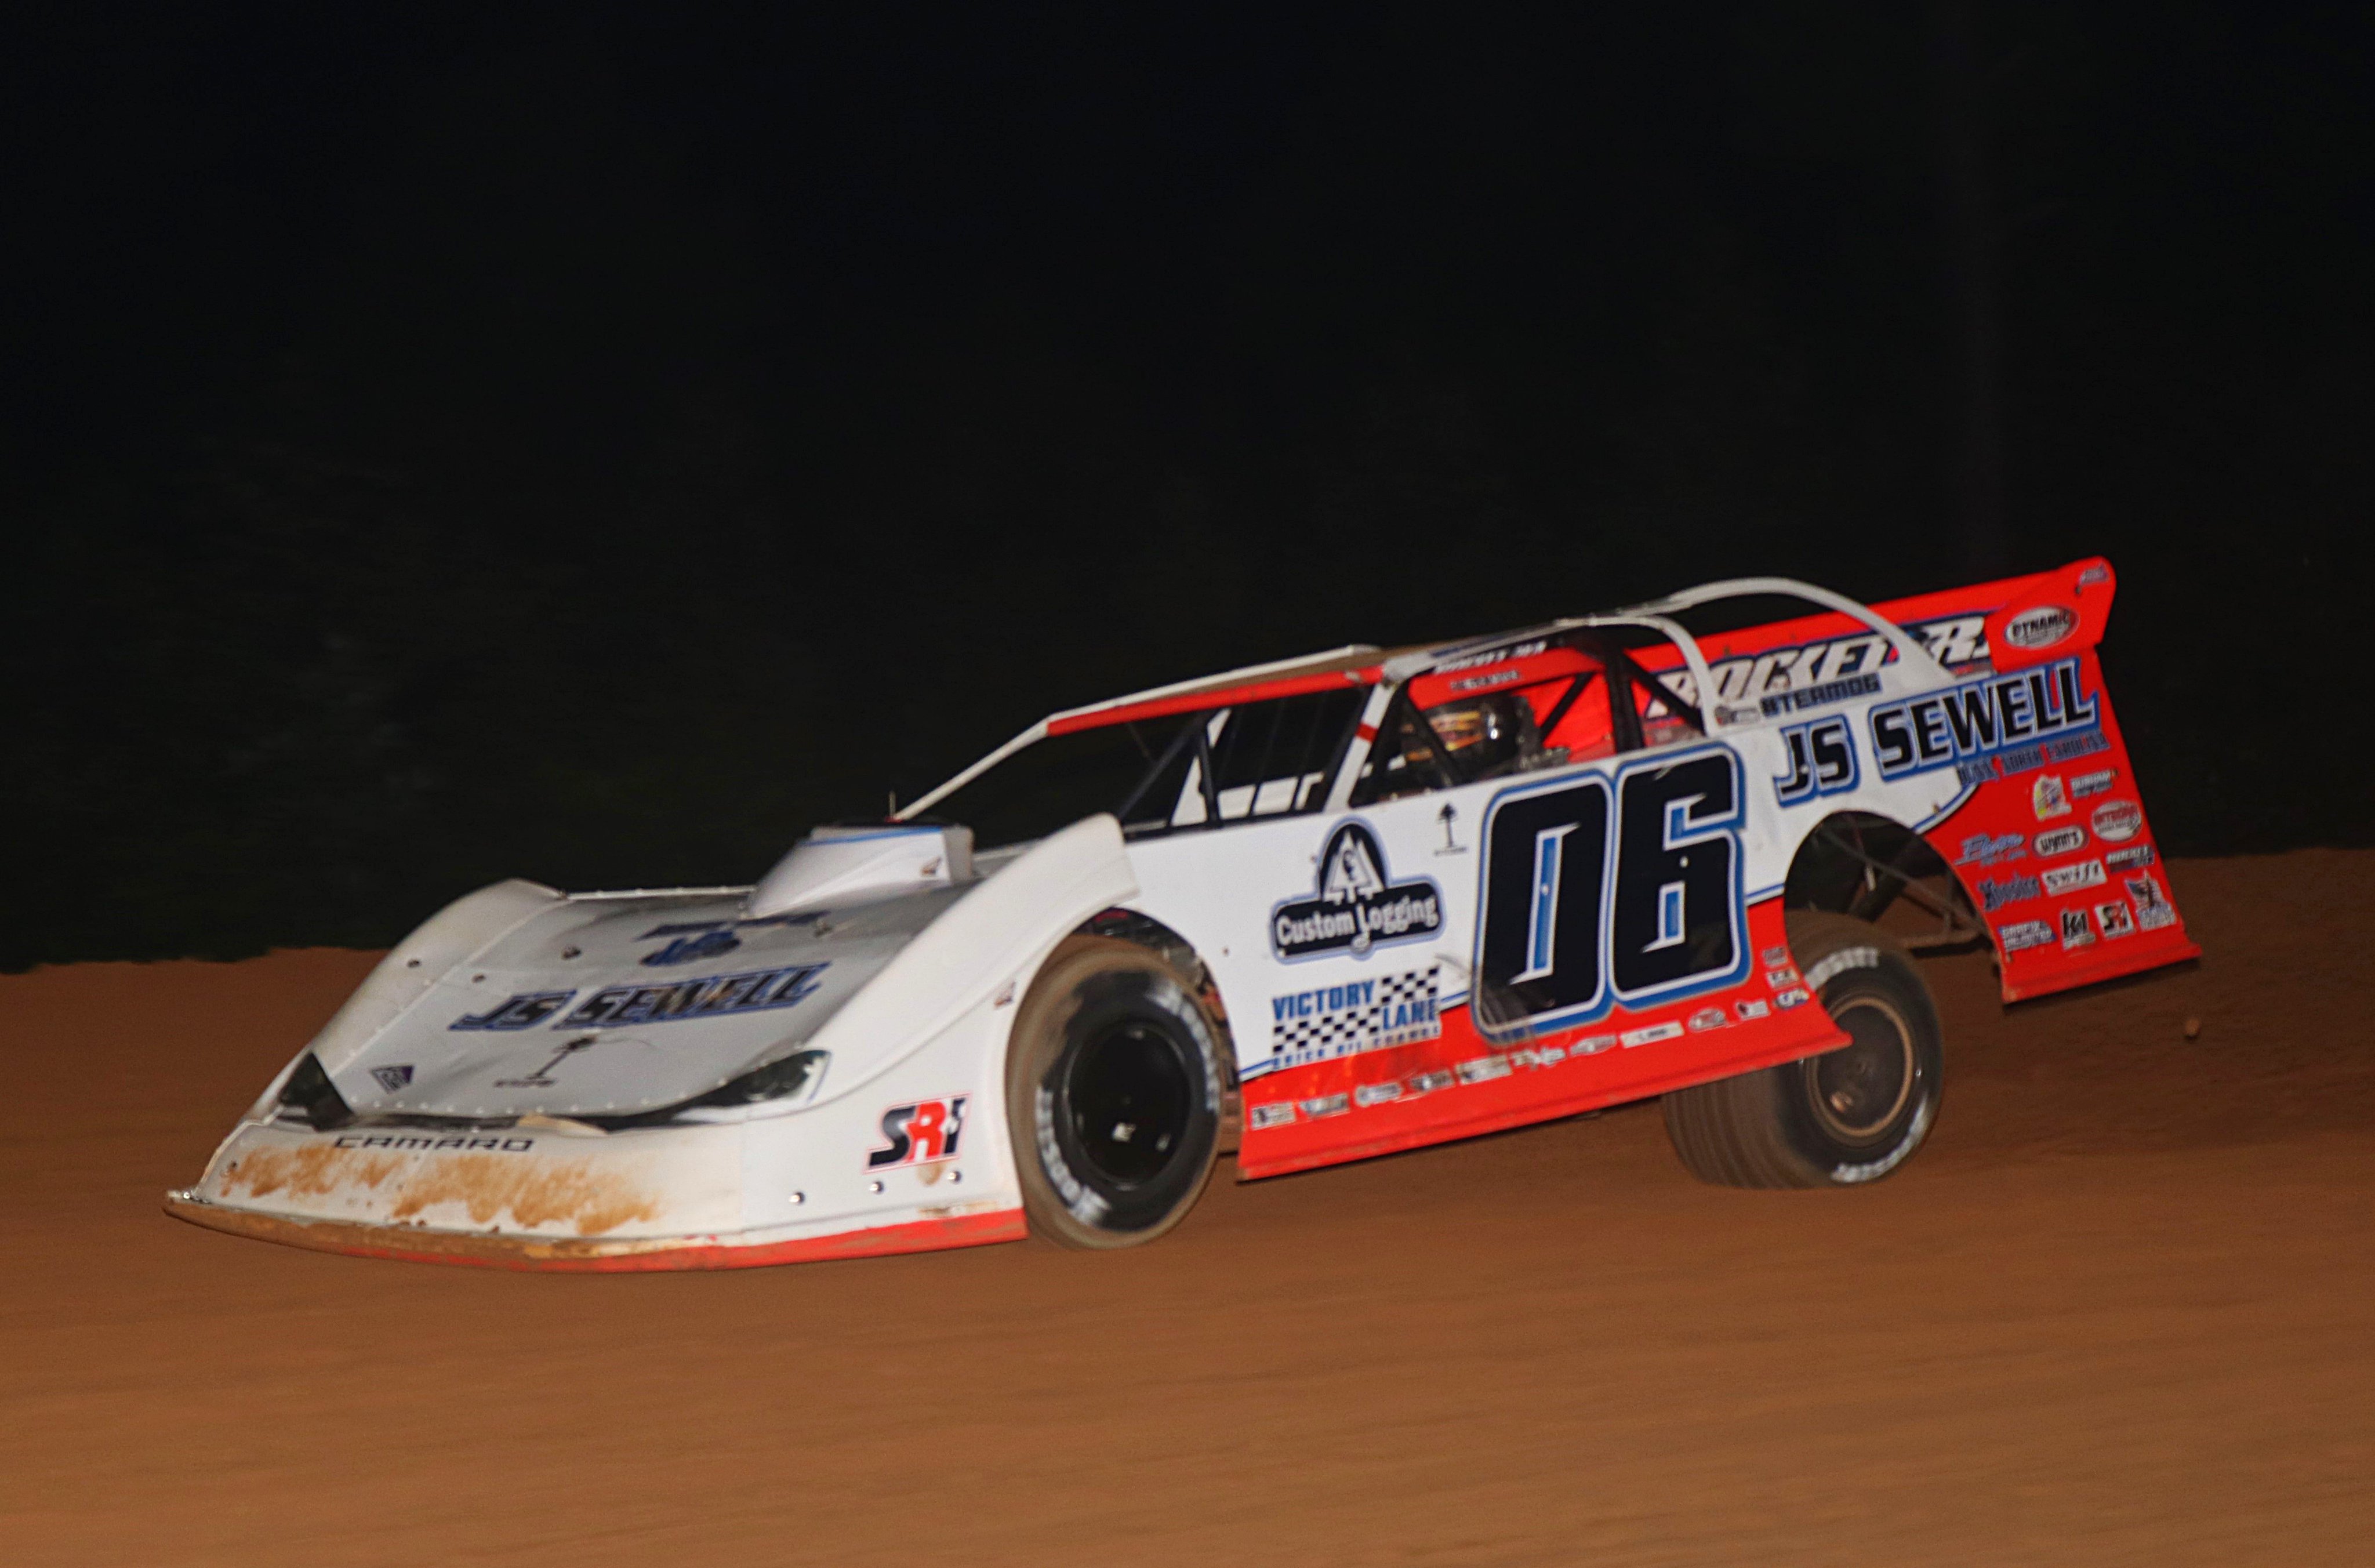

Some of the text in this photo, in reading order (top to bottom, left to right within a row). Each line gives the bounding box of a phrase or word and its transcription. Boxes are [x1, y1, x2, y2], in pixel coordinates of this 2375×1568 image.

[1774, 659, 2097, 805] JS SEWELL
[1473, 746, 1748, 1038] 06
[1276, 895, 1439, 946] Custom Logging
[448, 961, 832, 1030] JS SEWELL
[1272, 980, 1375, 1022] VICTORY
[1383, 996, 1439, 1030] LANE
[333, 1135, 534, 1152] CAMARO
